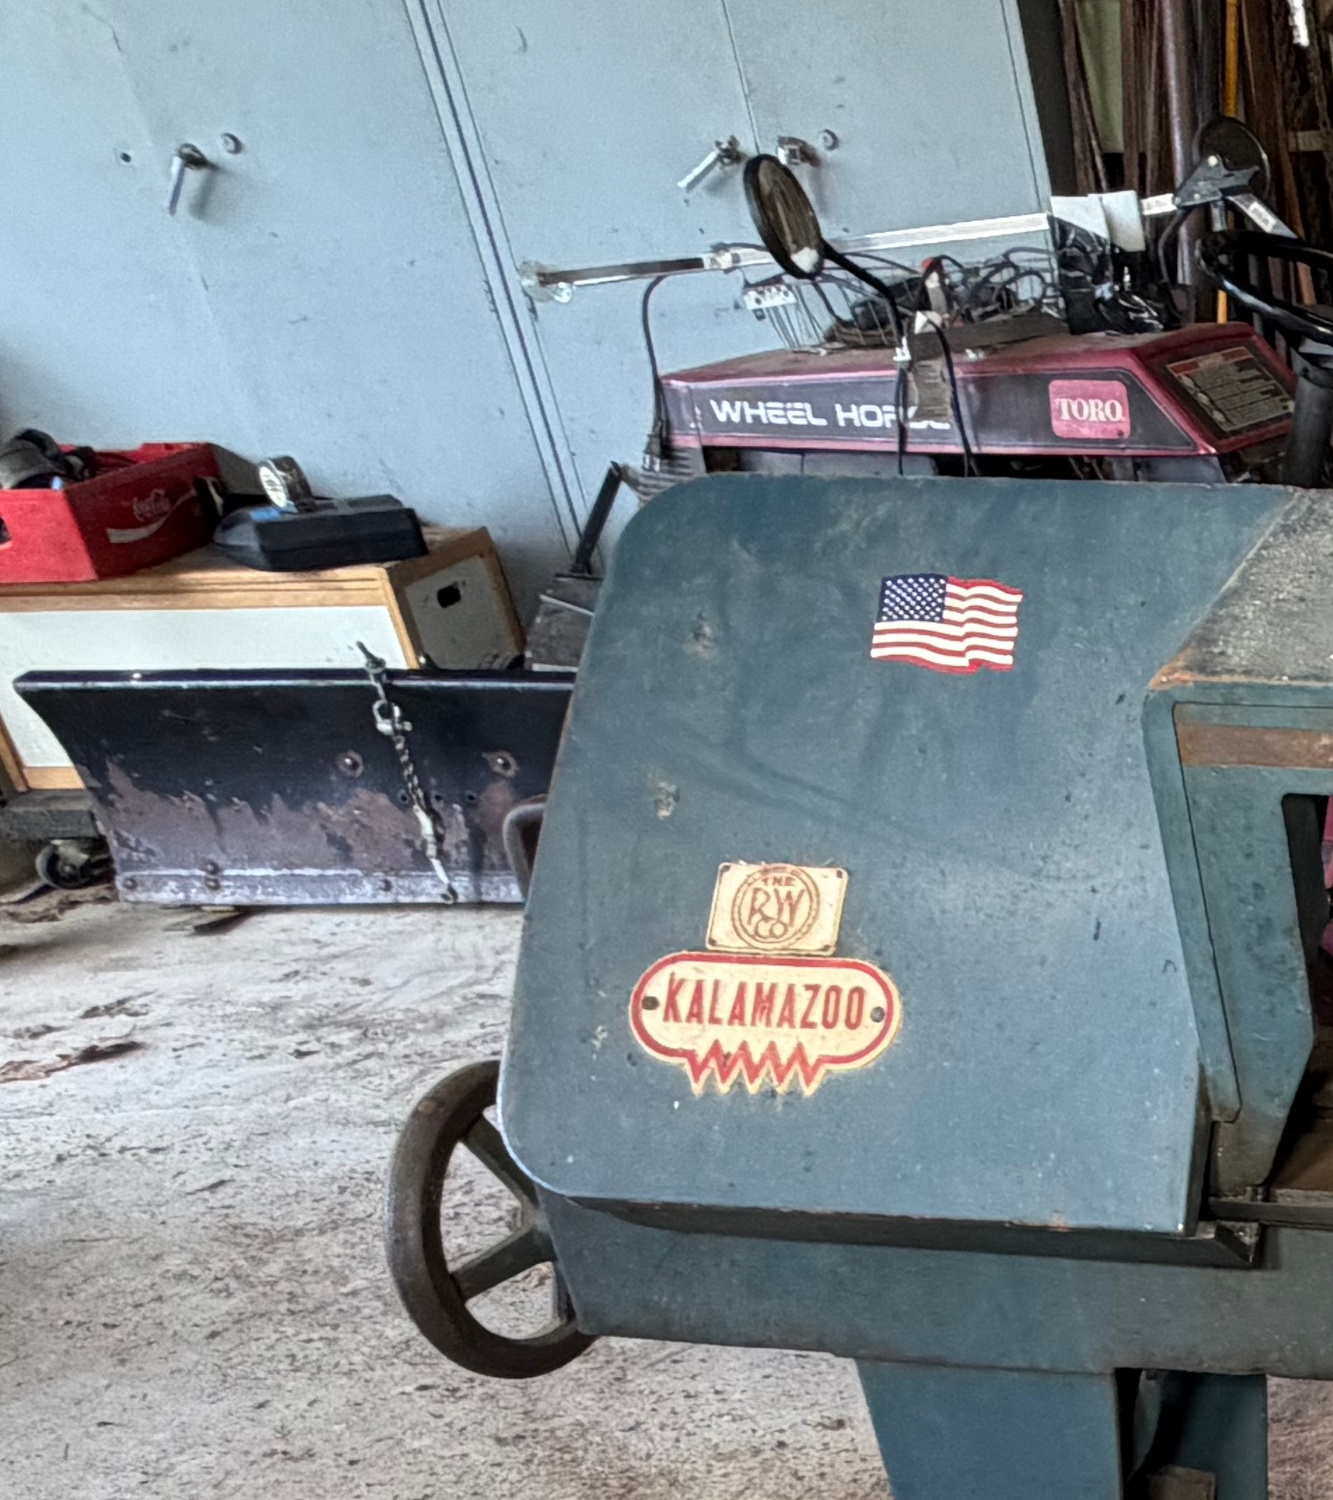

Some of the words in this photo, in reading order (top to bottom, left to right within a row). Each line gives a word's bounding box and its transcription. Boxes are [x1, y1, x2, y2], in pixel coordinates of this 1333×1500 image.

[709, 399, 828, 427] WHEEL
[834, 403, 951, 430] HOR
[1055, 397, 1126, 423] TORO
[662, 970, 867, 1031] KALAMAZOO
